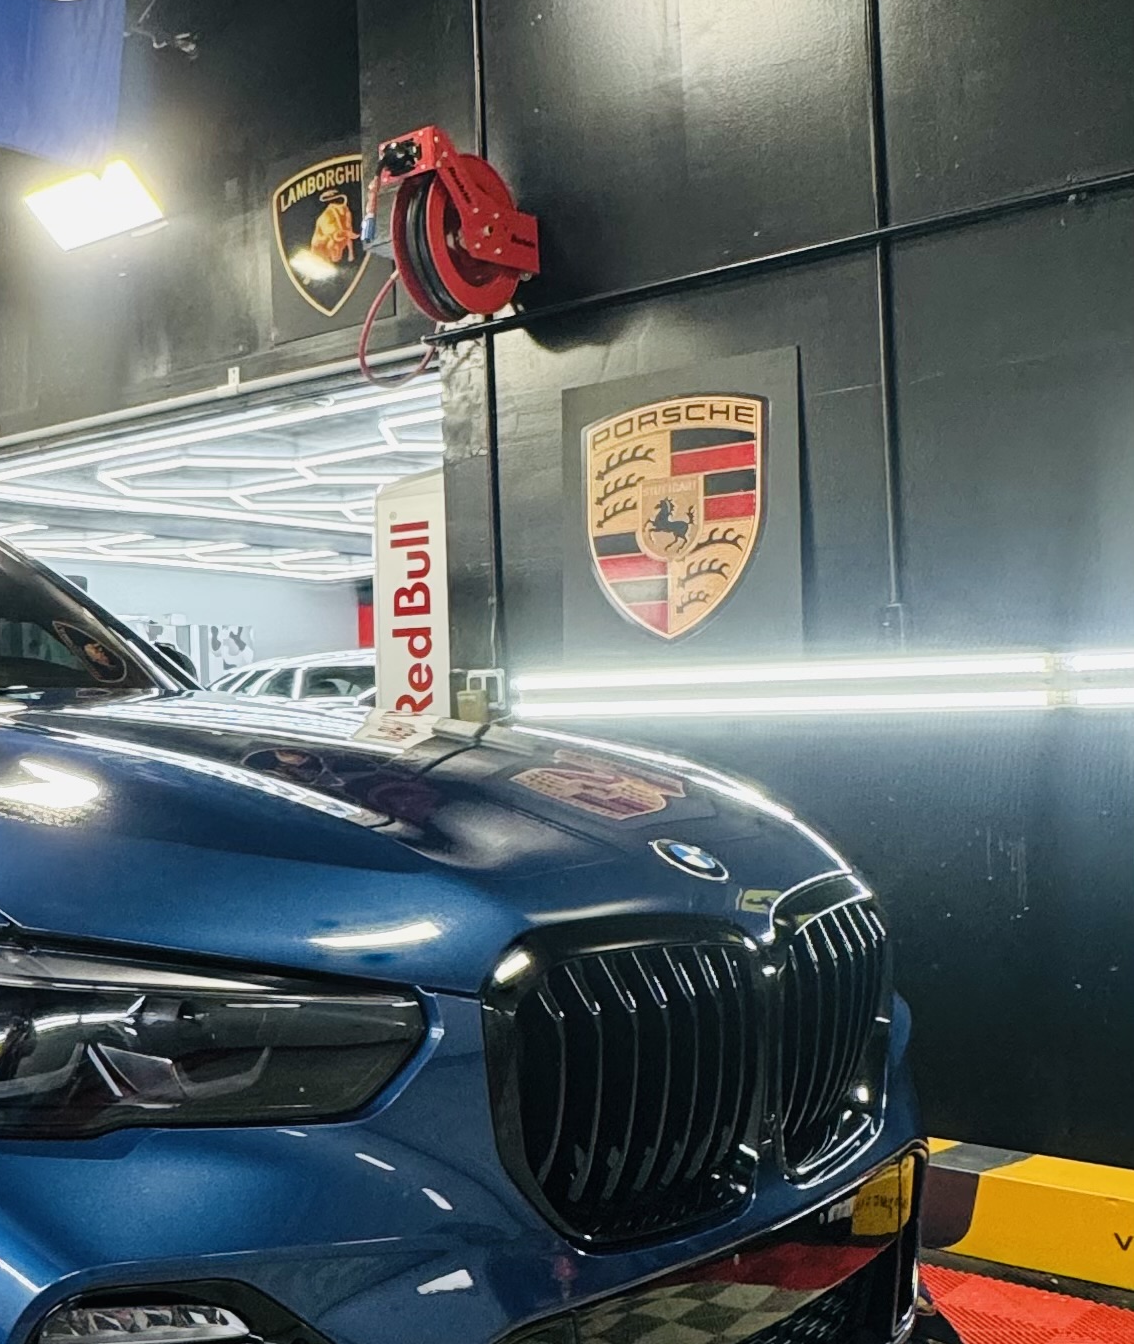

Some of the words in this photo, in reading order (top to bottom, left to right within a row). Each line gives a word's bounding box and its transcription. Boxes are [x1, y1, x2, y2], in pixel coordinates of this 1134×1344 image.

[280, 164, 360, 213] LAMBORGHI
[592, 403, 755, 451] PORSCHE
[390, 520, 431, 618] Bull
[392, 626, 434, 713] Red
